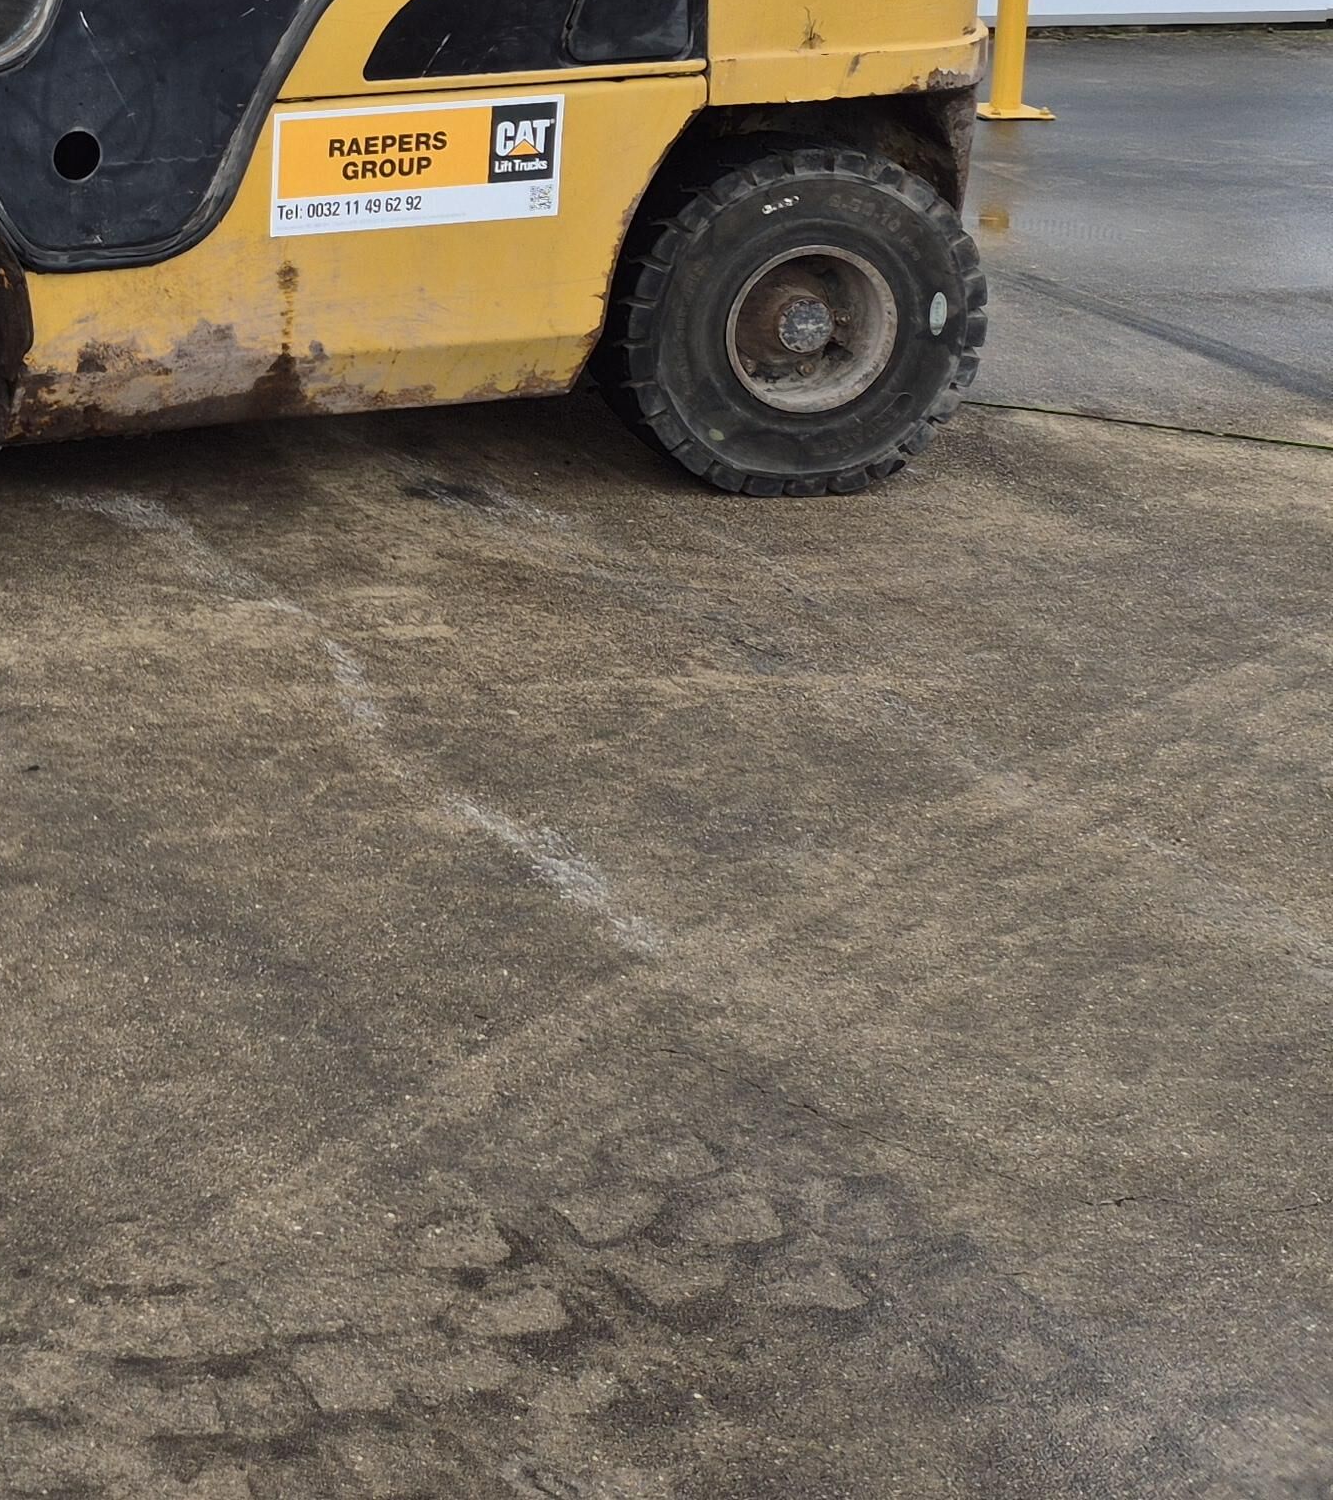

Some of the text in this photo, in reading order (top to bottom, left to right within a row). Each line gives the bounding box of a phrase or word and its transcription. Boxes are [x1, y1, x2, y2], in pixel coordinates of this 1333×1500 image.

[329, 131, 447, 158] RAEPERS
[496, 119, 551, 157] CAT
[342, 157, 432, 181] GROUP
[494, 158, 548, 173] Lift Trucks
[277, 195, 422, 221] Tel: 0032 11 49 62 92
